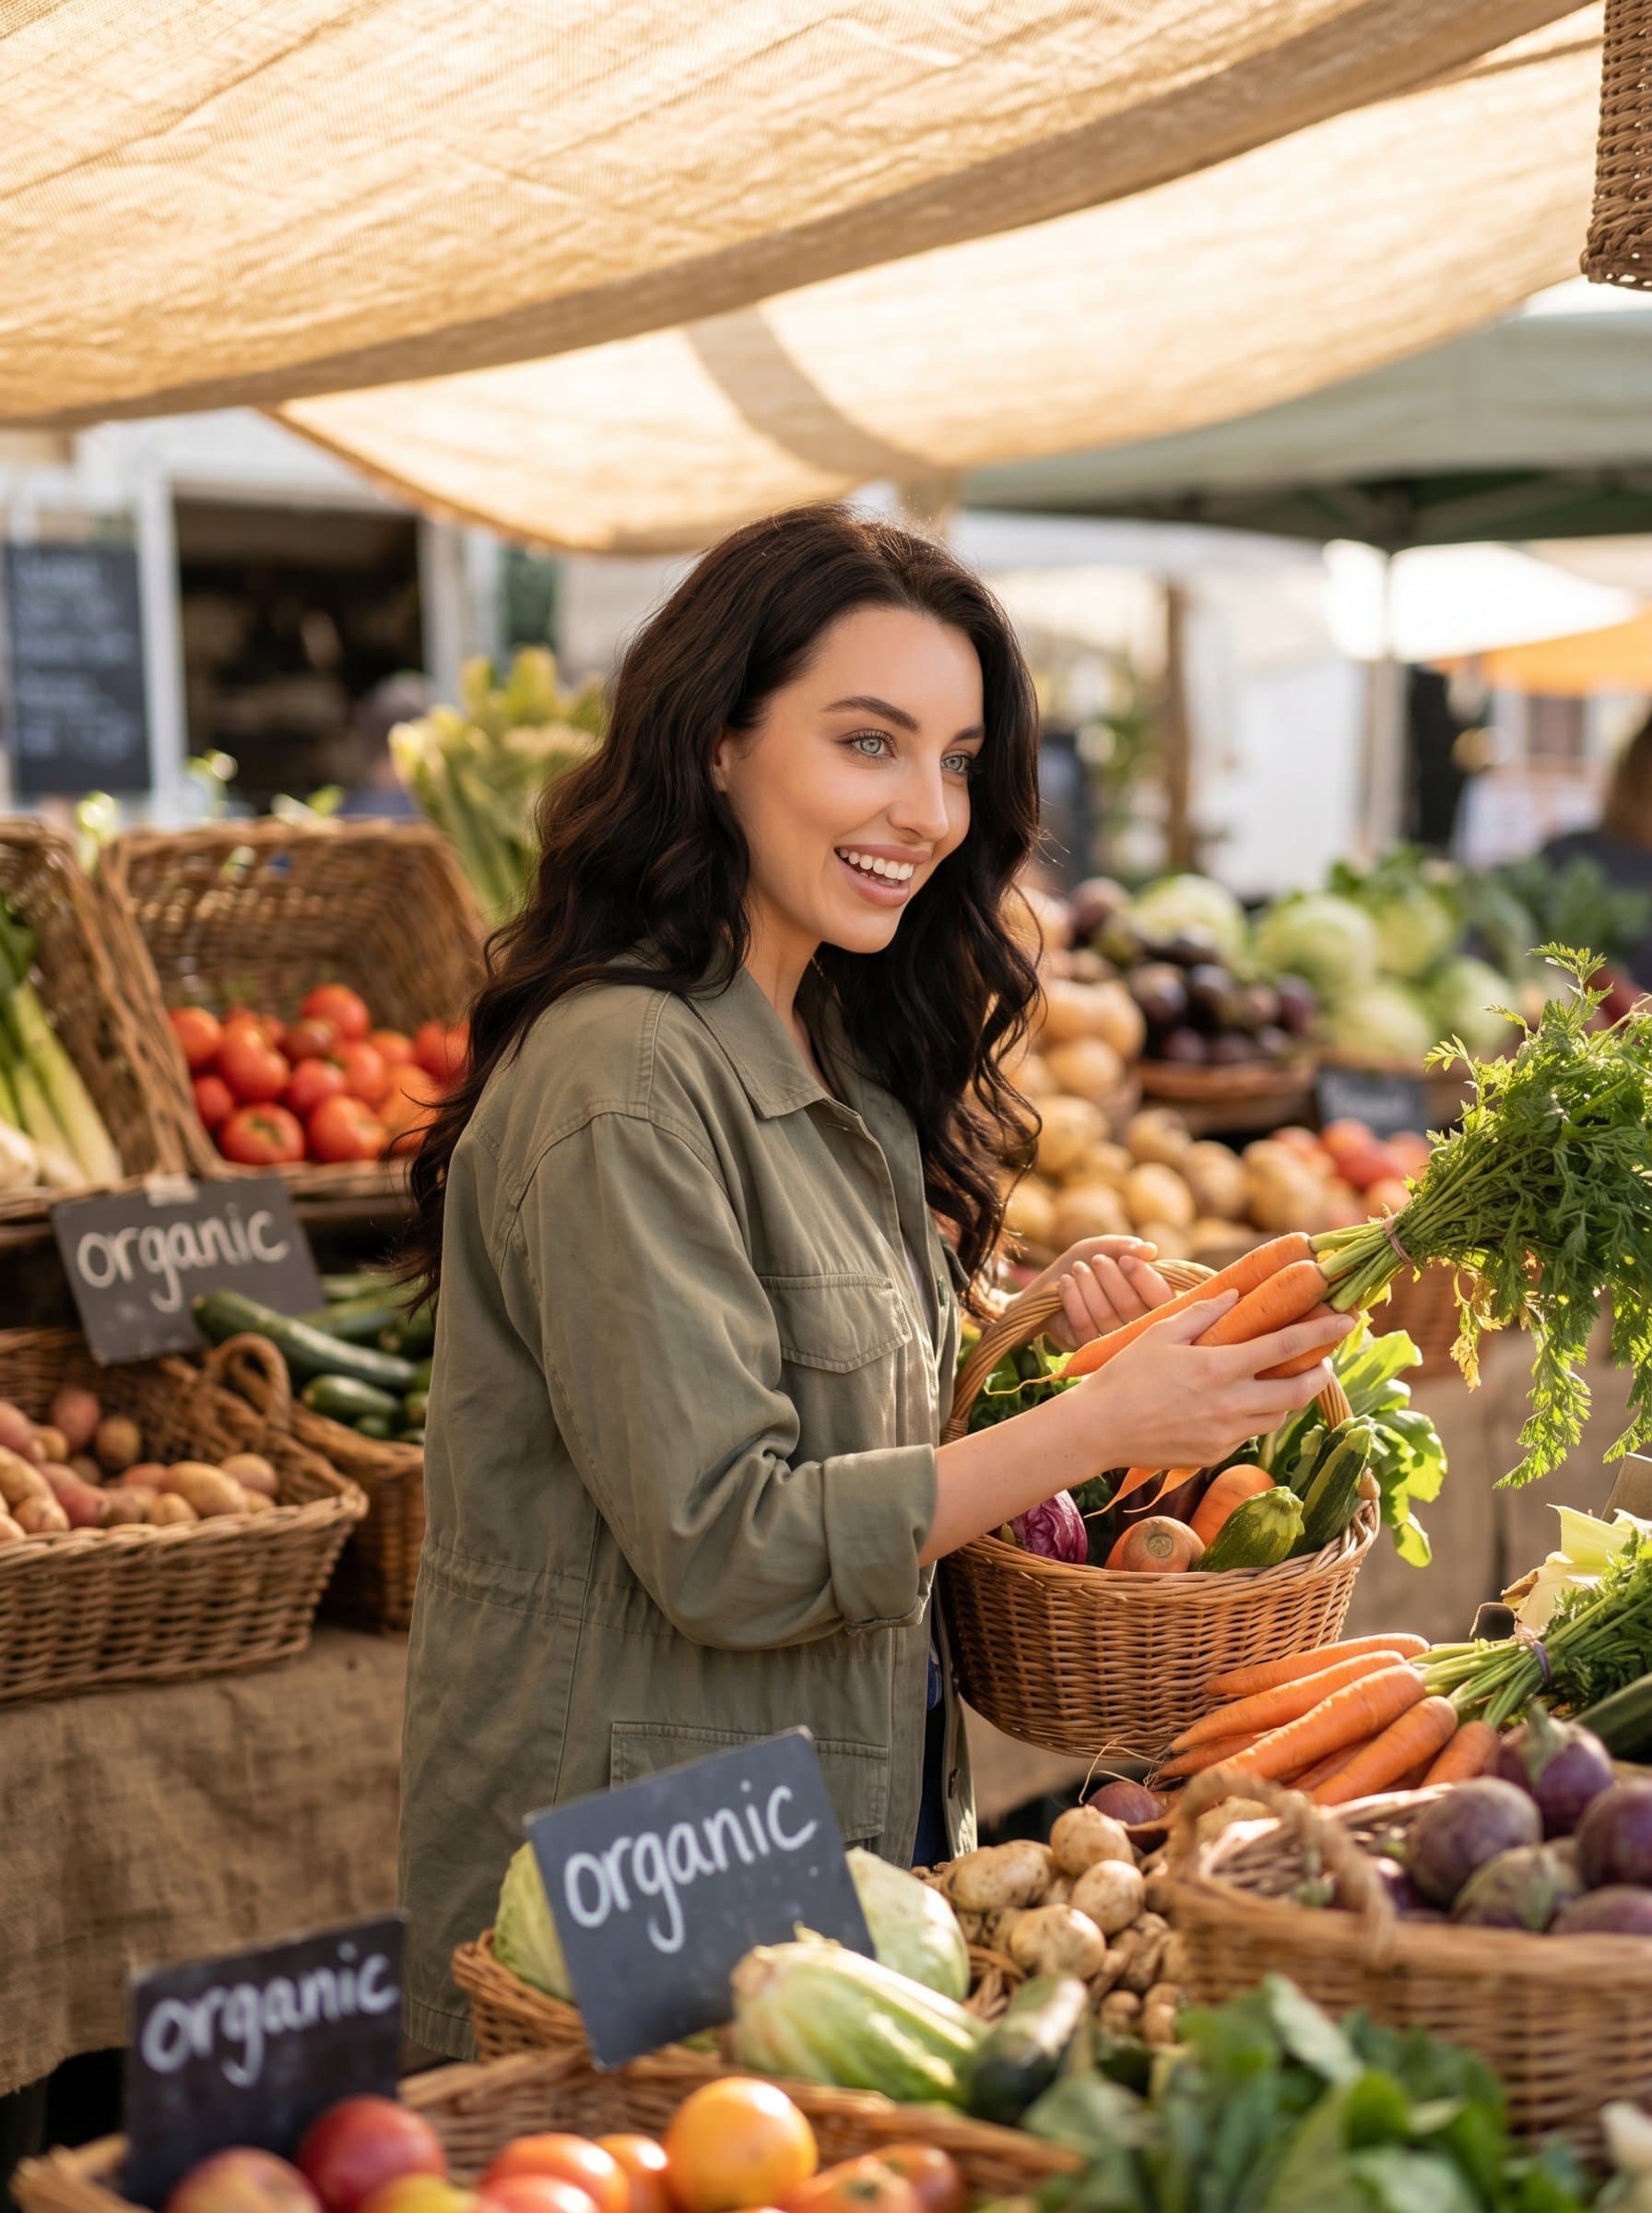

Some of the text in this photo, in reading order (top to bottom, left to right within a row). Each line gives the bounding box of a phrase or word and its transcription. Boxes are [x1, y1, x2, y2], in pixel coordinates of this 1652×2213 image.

[77, 1202, 289, 1313] organic
[563, 1779, 819, 1955] organic
[142, 1941, 401, 2089] organic
